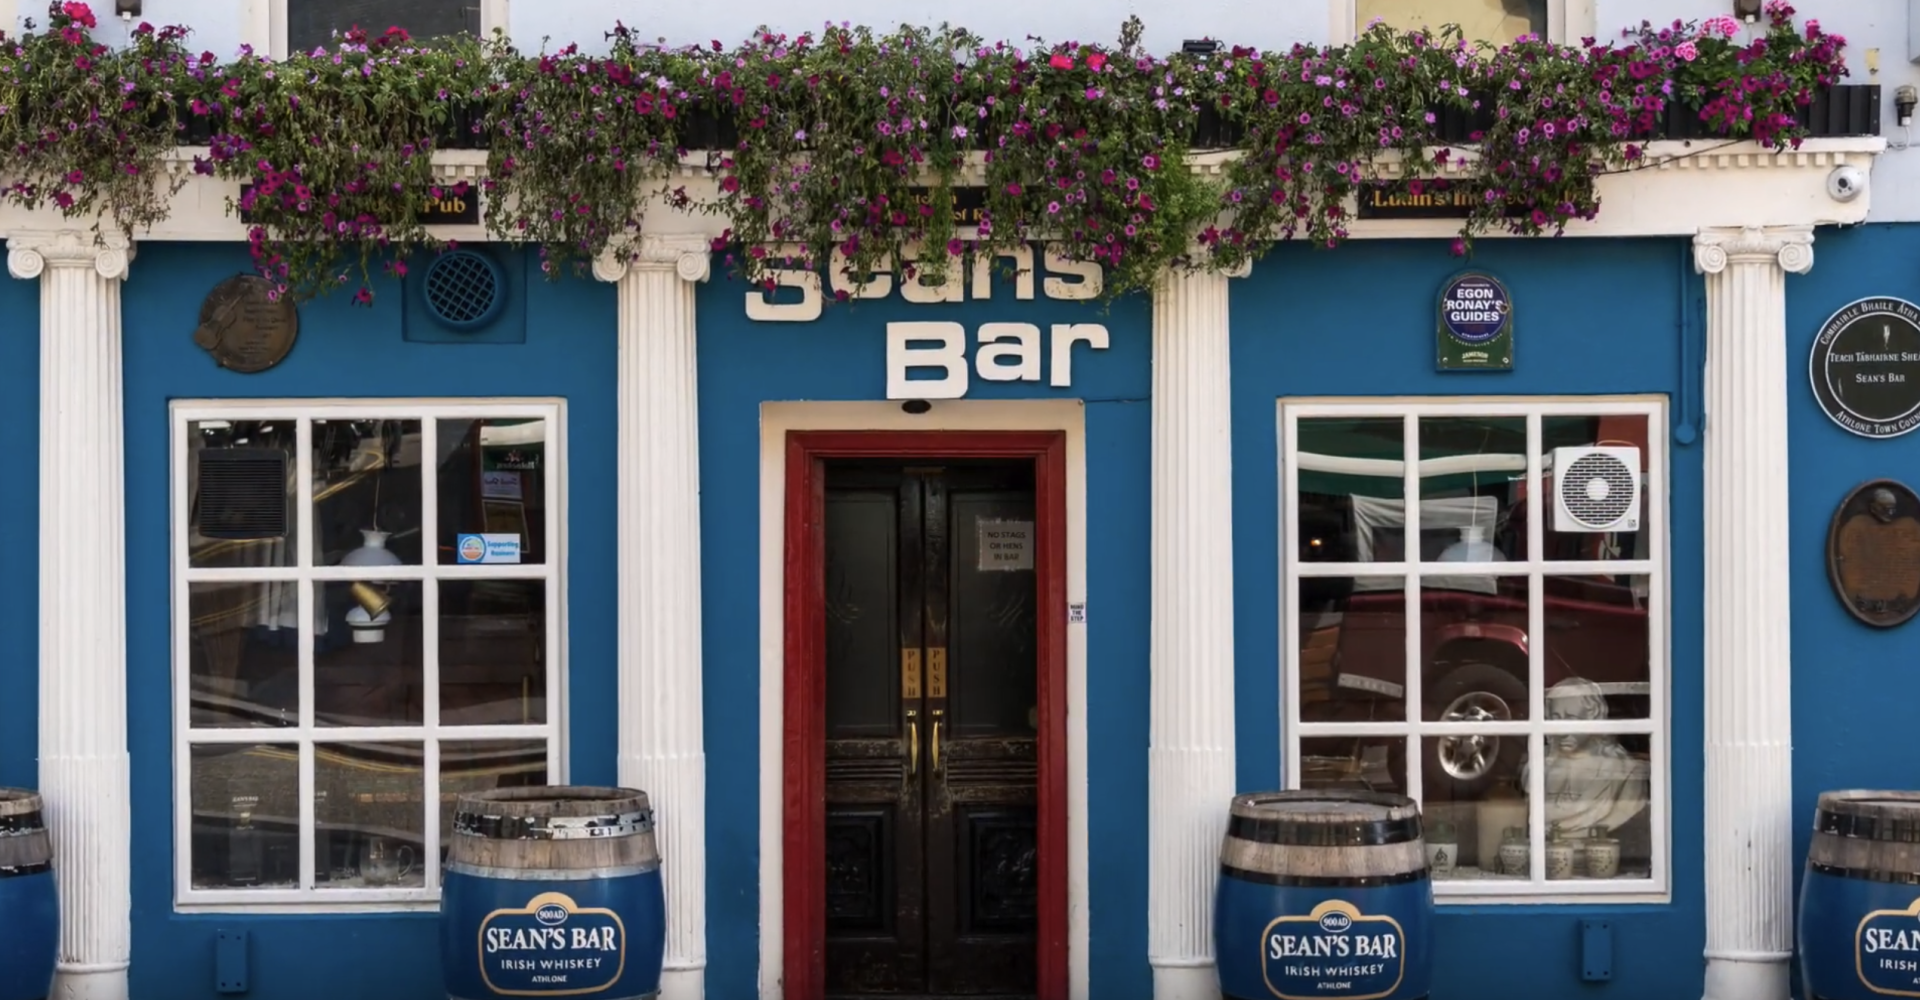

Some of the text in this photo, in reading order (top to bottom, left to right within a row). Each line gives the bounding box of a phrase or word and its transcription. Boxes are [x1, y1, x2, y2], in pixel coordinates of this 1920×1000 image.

[1456, 289, 1493, 299] EGON
[1447, 300, 1505, 311] RONAY'S
[1860, 302, 1894, 313] BHAILE
[1450, 311, 1500, 322] GUIDES
[886, 321, 1109, 399] Bar
[1901, 351, 1920, 362] SHE
[1856, 372, 1905, 383] SEAN'S BAR
[1835, 410, 1872, 433] ATHLONE
[1873, 422, 1898, 434] TOWN
[987, 531, 1026, 539] NO STAGS
[989, 542, 1023, 550] OR HENS
[907, 650, 916, 696] PUSH
[932, 650, 941, 696] PUSH
[486, 926, 617, 953] SEAN'S BAR
[1270, 933, 1397, 960] SEAN'S BAR
[501, 958, 602, 970] IRISH WHISKEY
[1880, 958, 1917, 971] IRISH
[1285, 963, 1384, 977] IRISH WHISKEY
[531, 975, 568, 983] ATHLONE
[1317, 981, 1352, 989] ATHLONE
